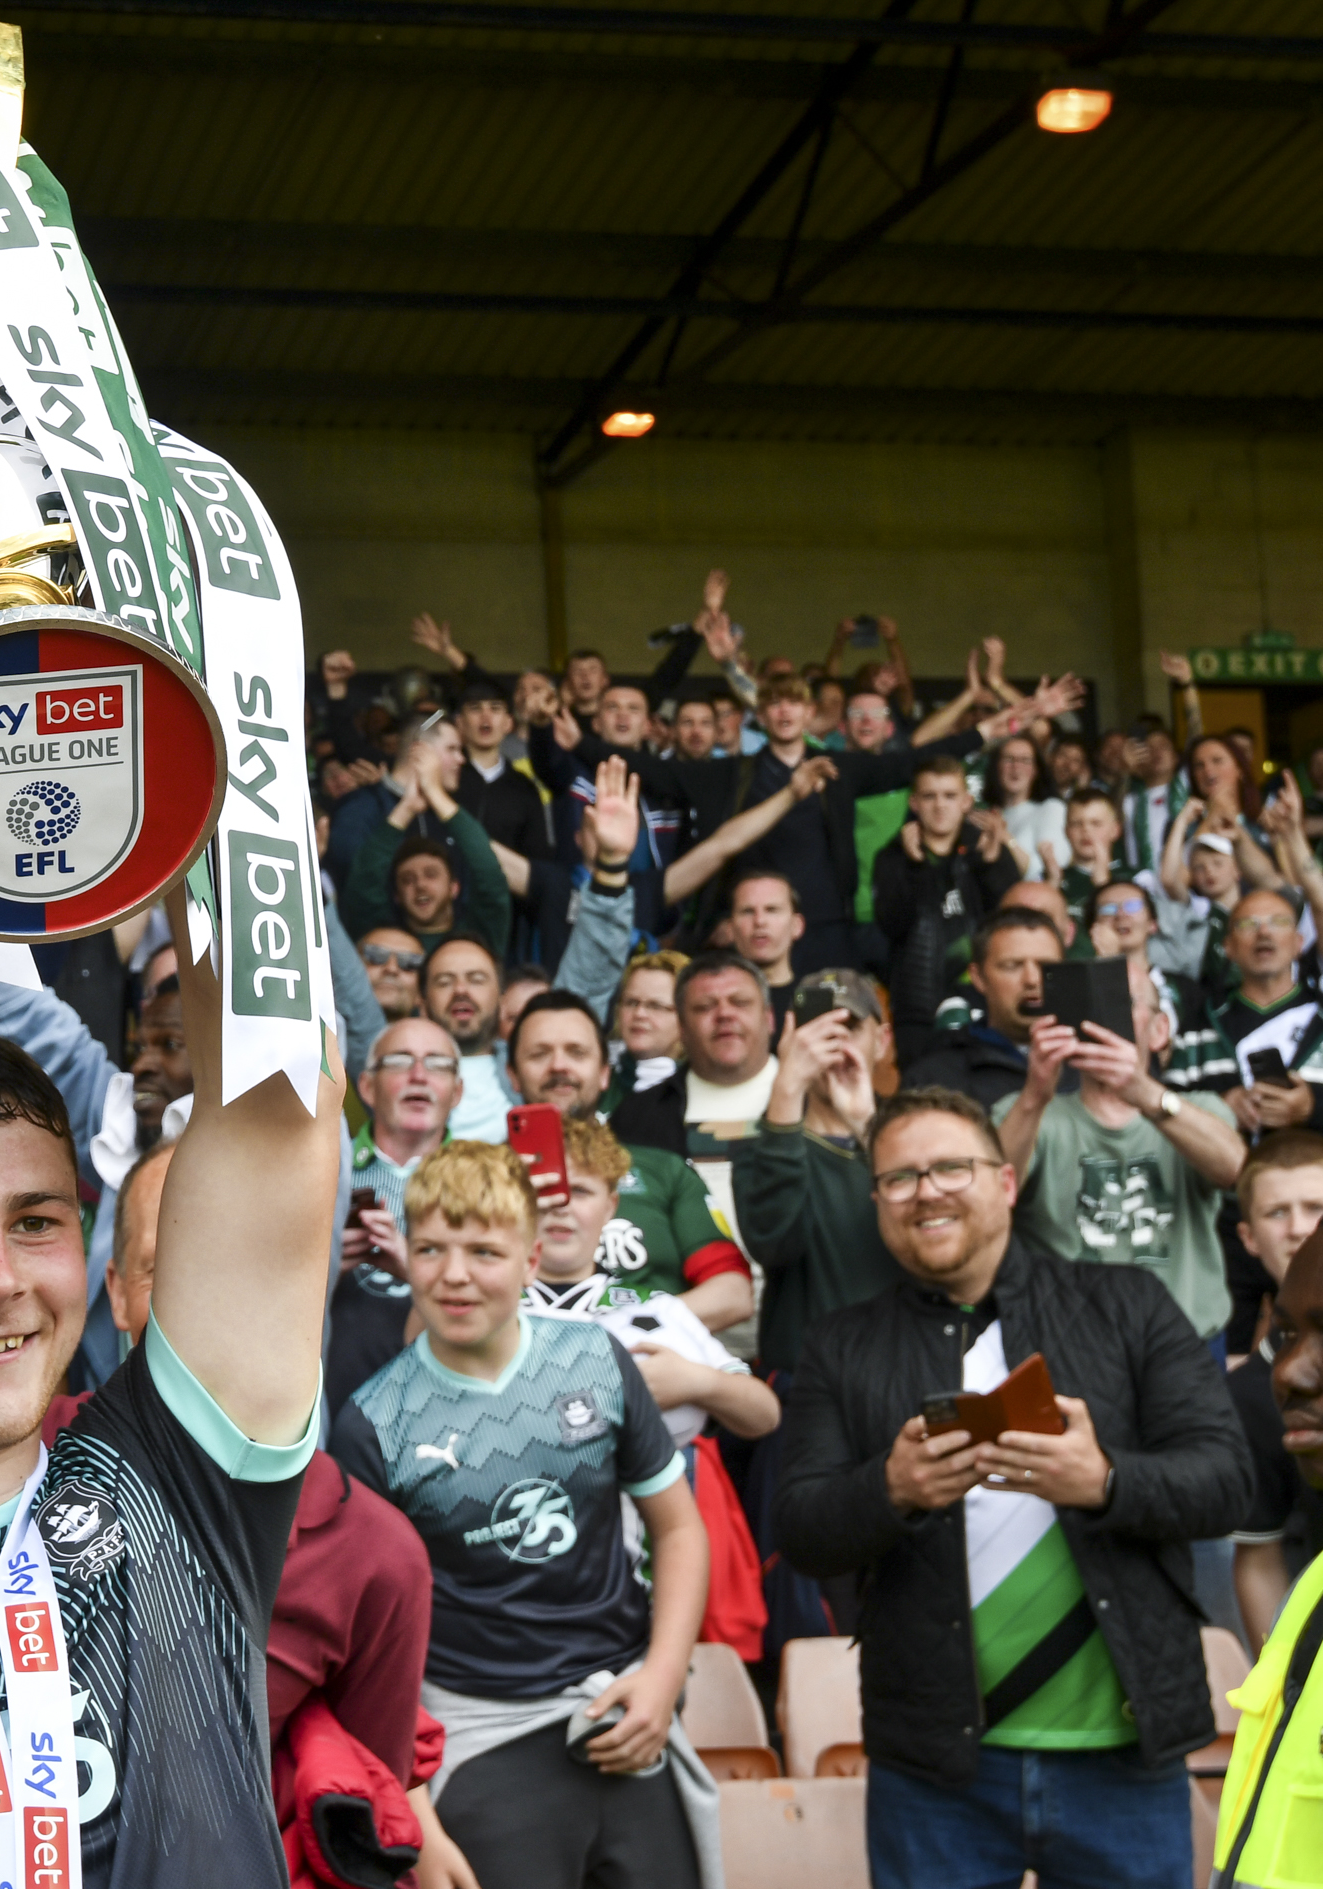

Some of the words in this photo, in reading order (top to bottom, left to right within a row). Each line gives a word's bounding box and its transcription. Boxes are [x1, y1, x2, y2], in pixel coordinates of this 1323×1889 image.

[6, 324, 105, 463] sky
[82, 489, 160, 636] bet
[174, 465, 264, 581] bet
[1228, 652, 1307, 678] EXIT
[46, 692, 115, 725] bet
[68, 736, 120, 760] ONE
[228, 670, 290, 824] sky
[15, 850, 75, 877] EFL
[245, 851, 303, 1000] bet
[509, 1486, 578, 1556] 35
[3, 1551, 39, 1596] sky
[14, 1609, 50, 1668] bet
[24, 1732, 63, 1800] sky
[33, 1815, 65, 1886] bet
